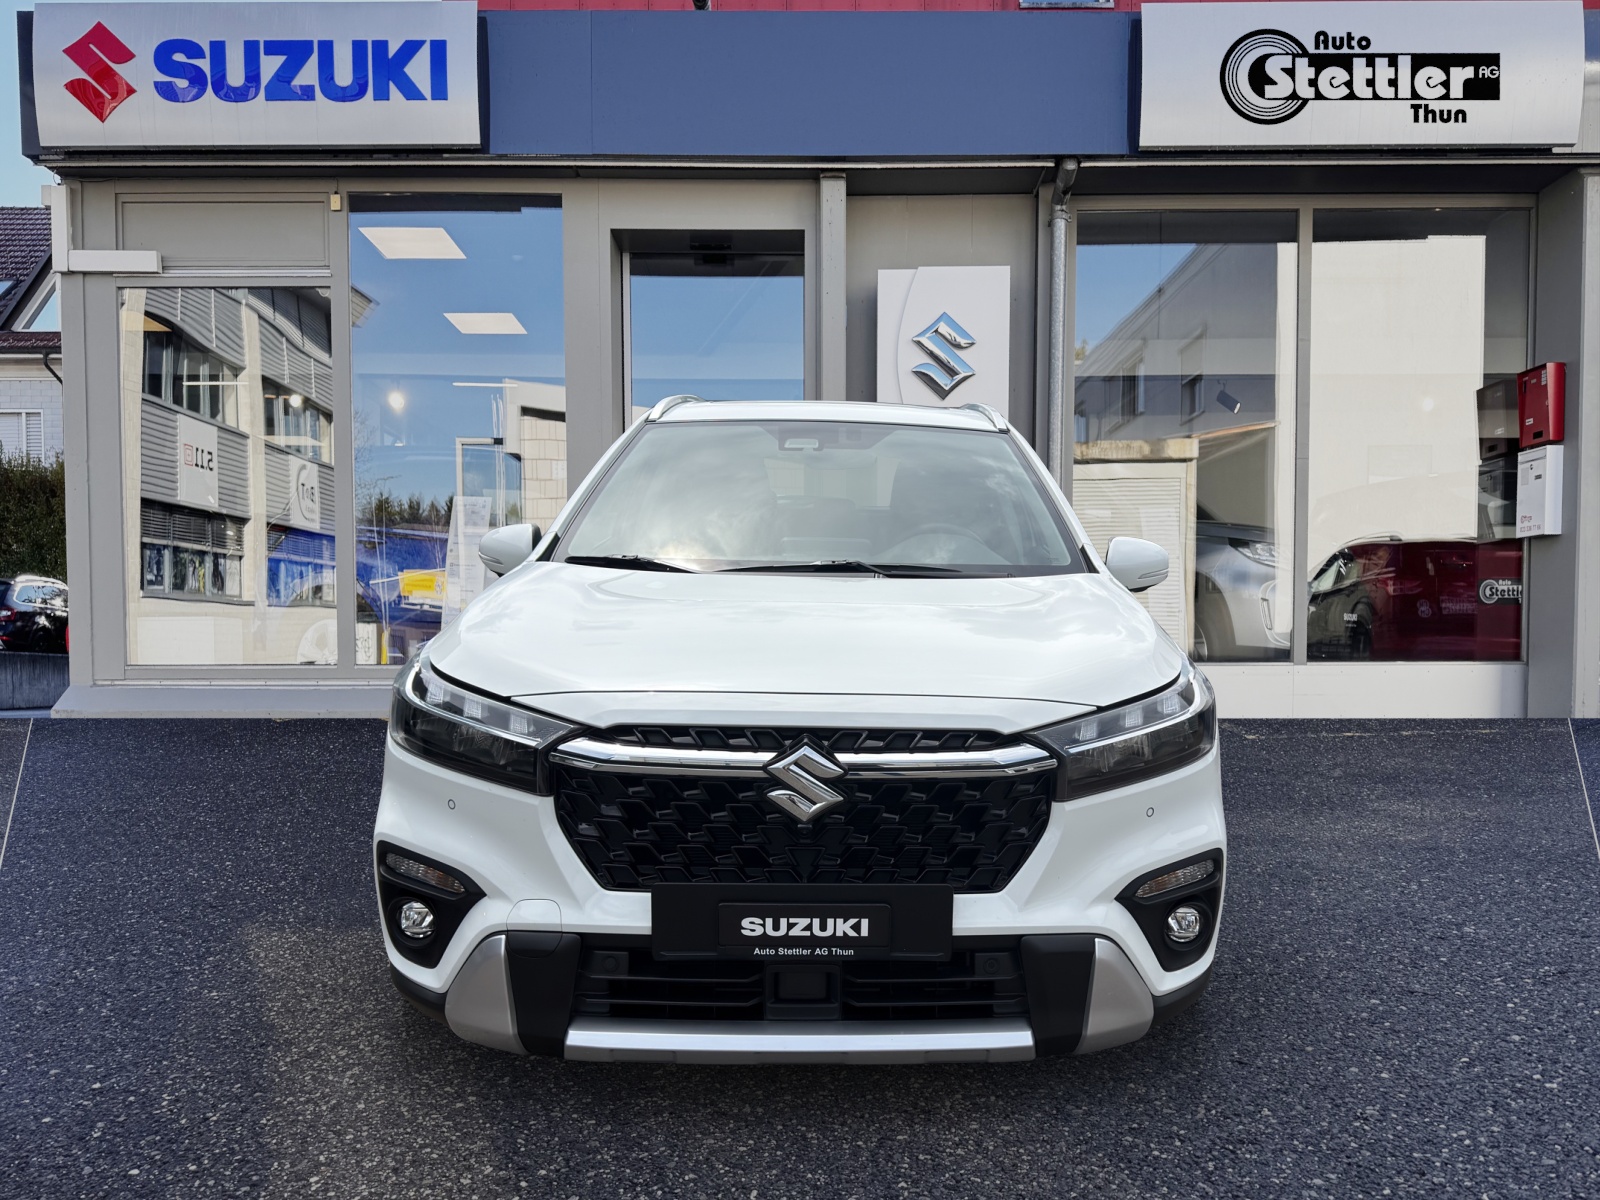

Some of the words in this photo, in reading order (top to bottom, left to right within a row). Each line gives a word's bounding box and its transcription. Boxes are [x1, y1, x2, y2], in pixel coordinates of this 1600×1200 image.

[1314, 30, 1371, 50] Auto
[153, 39, 447, 102] SUZUKI
[1264, 54, 1474, 99] Stettler
[1478, 66, 1499, 78] AG
[1410, 104, 1467, 123] Thun
[1488, 586, 1522, 597] Stettl
[740, 917, 869, 937] SUZUKI
[753, 947, 775, 956] Auto
[778, 947, 811, 956] Stettler
[815, 947, 828, 956] AG
[831, 948, 854, 957] Thun
